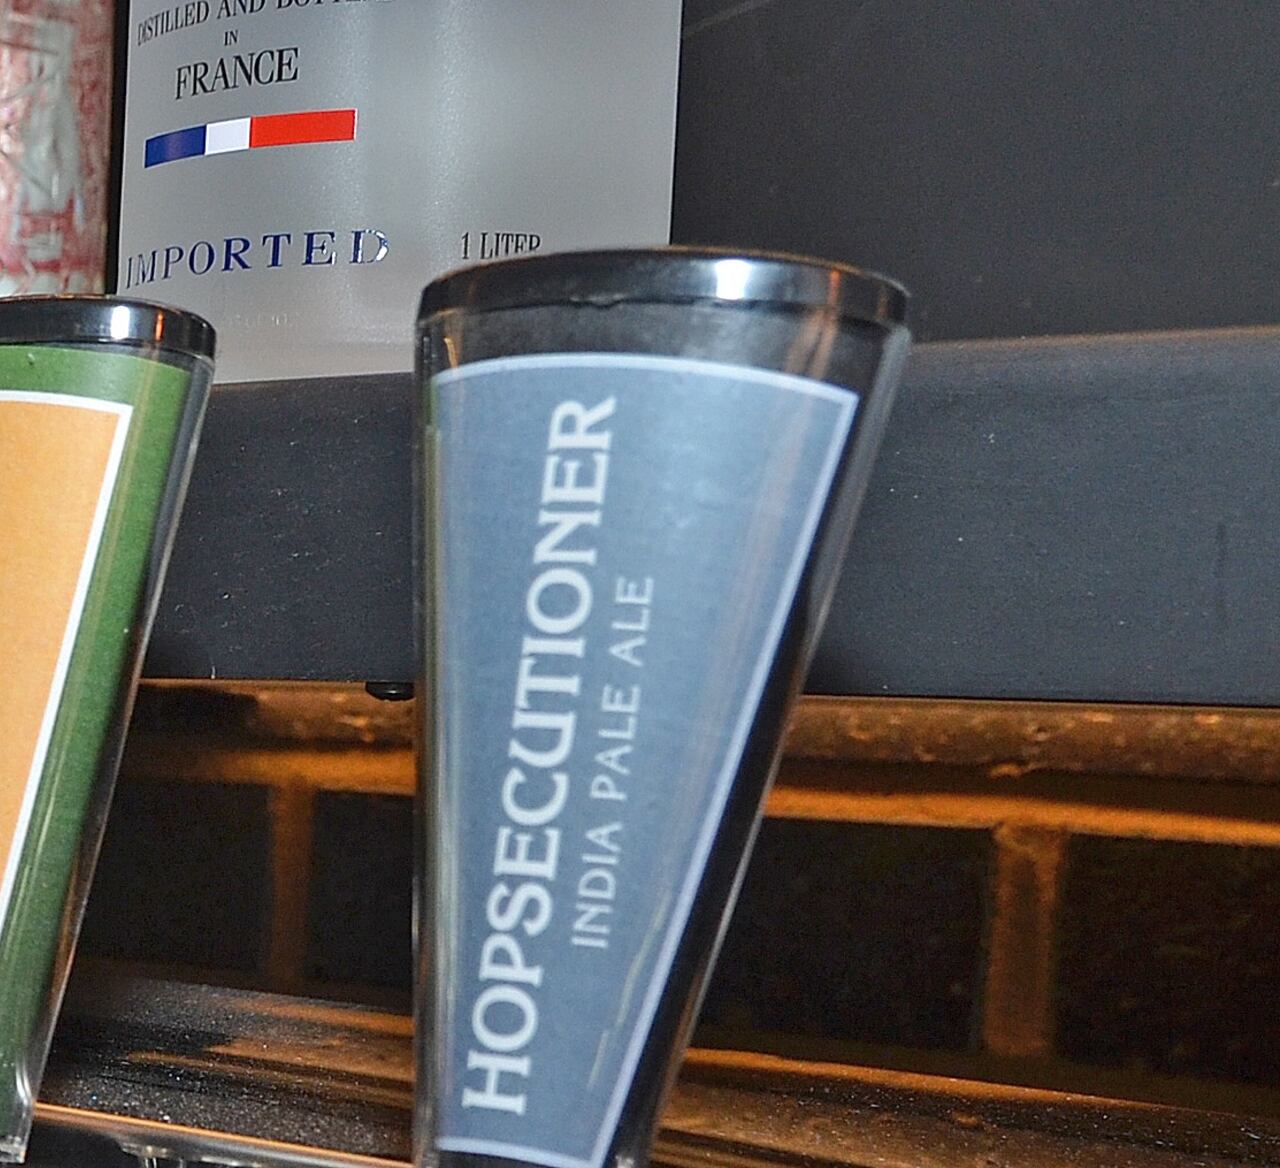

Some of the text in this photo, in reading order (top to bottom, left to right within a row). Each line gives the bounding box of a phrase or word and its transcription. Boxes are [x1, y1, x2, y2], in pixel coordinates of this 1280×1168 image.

[138, 1, 209, 46] DISTILLED
[224, 29, 239, 47] IN
[174, 47, 299, 100] FRANCE
[125, 228, 390, 290] IMPORTED
[460, 231, 470, 260] 1
[462, 395, 617, 1116] HOPSECUTIONER
[571, 575, 654, 949] INDIA PALE ALE
